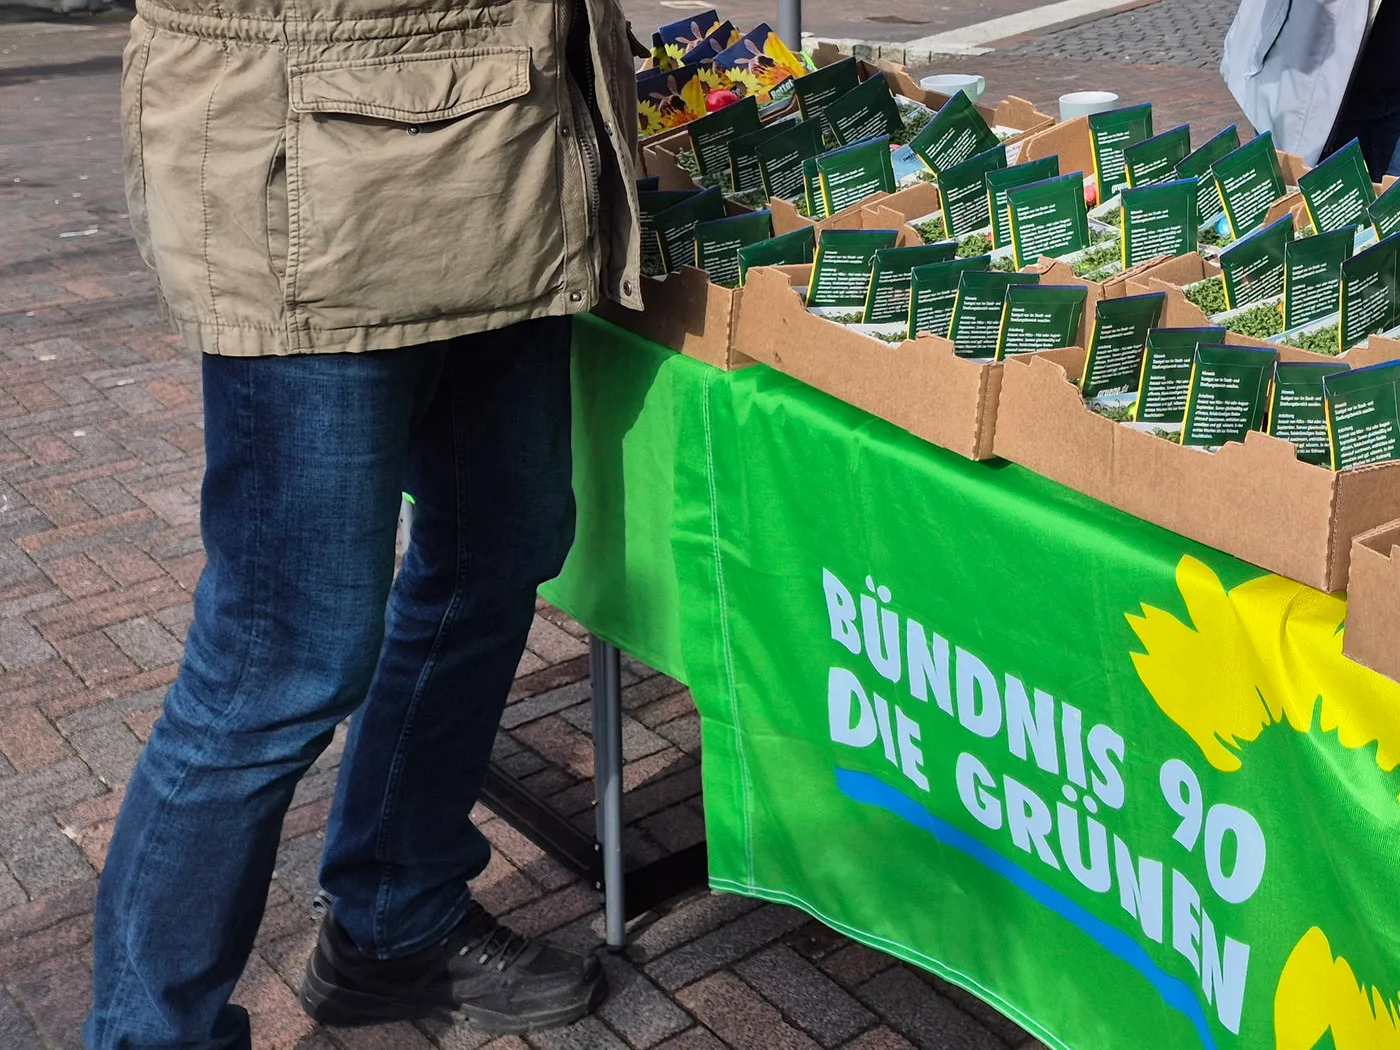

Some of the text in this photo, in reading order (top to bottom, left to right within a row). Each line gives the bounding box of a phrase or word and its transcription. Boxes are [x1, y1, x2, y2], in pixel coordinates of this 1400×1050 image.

[822, 567, 1267, 905] BÜNDNIS 90
[827, 666, 1251, 1035] DIE GRÜNEN
